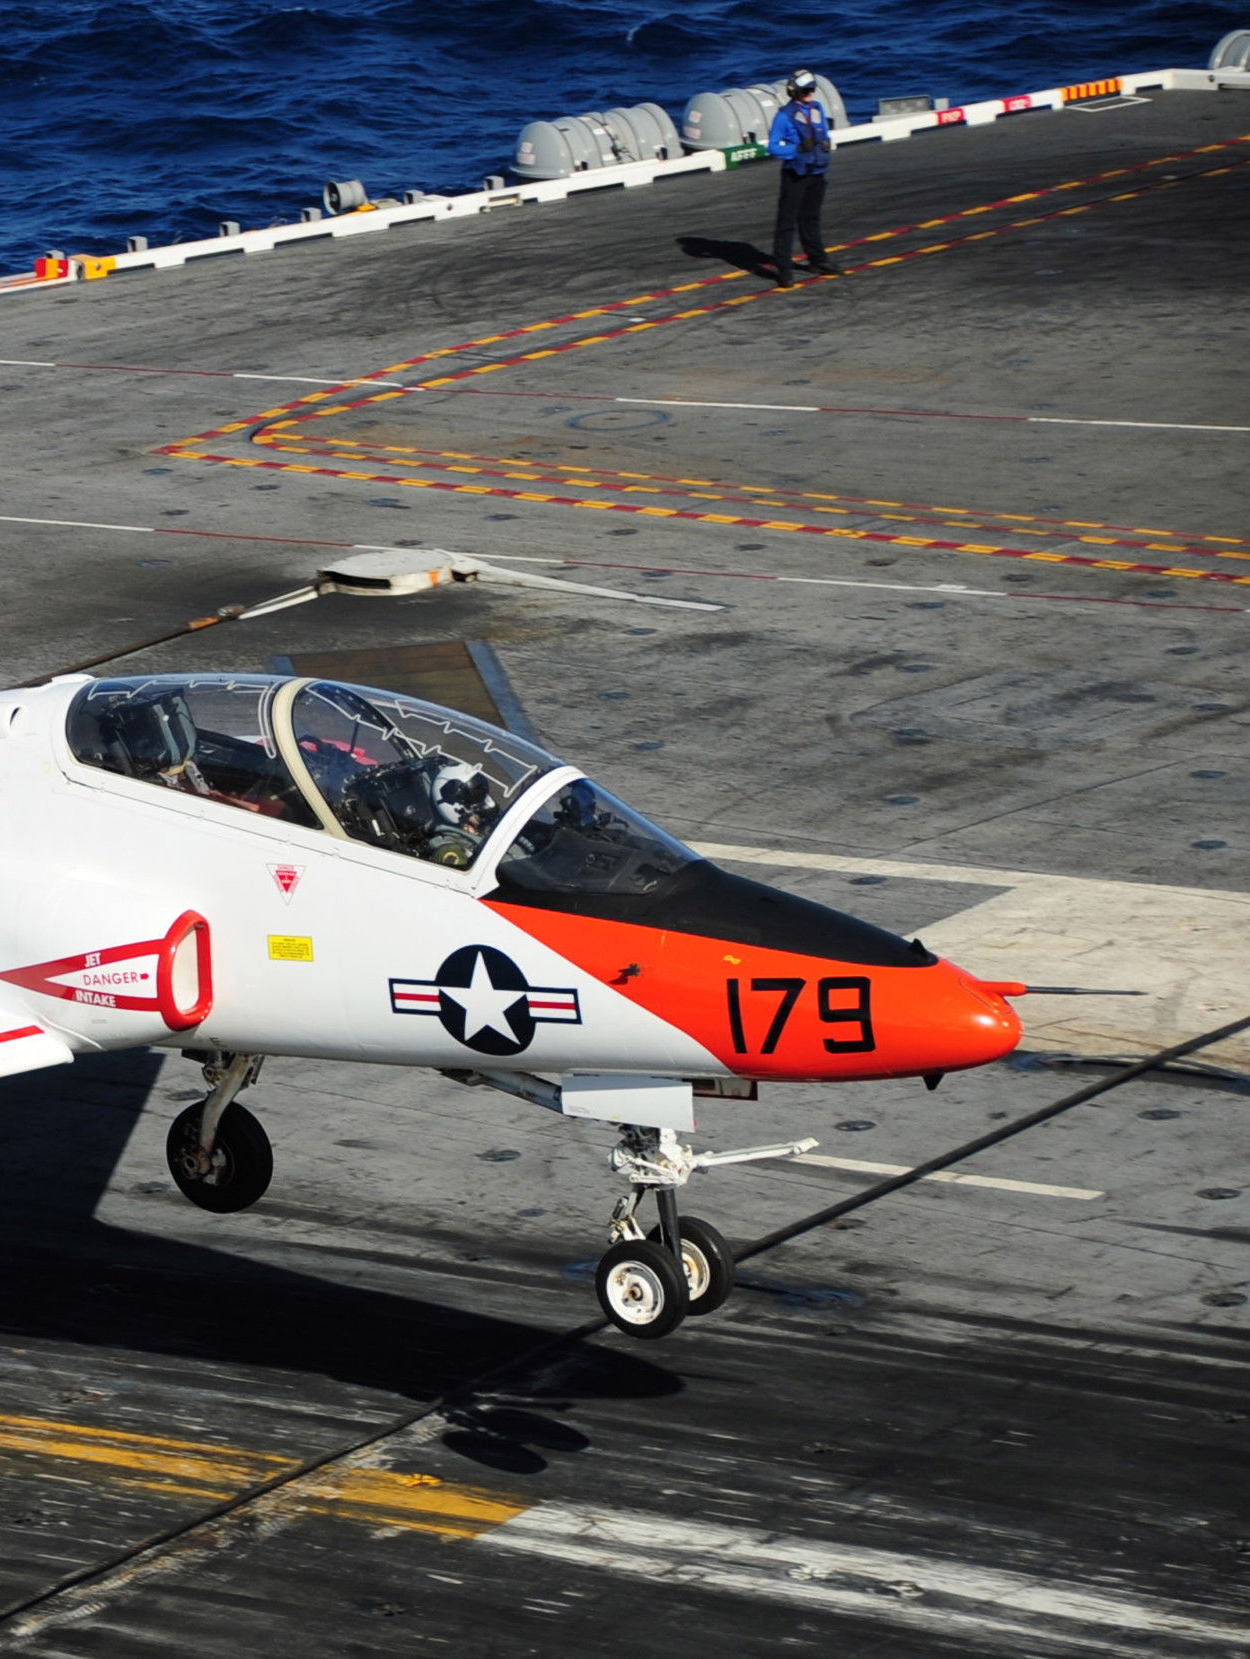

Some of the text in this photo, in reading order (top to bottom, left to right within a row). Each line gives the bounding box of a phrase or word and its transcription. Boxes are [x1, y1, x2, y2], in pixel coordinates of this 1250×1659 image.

[84, 952, 101, 968] JET
[83, 971, 138, 986] DANGER
[74, 990, 117, 1008] INTAKE
[726, 976, 876, 1054] 179
